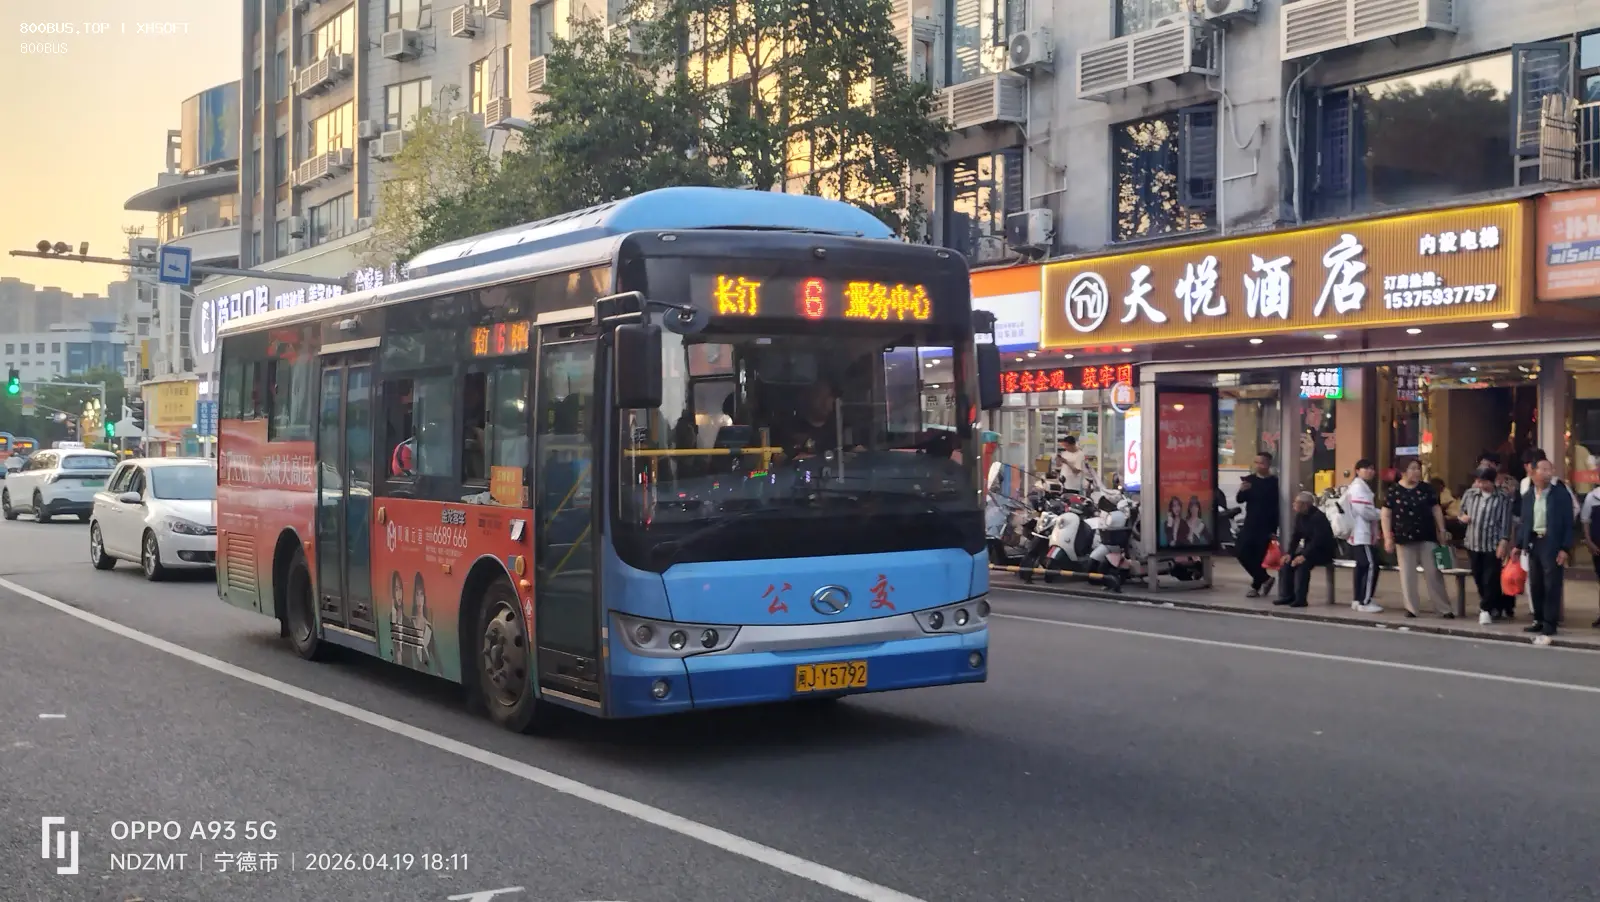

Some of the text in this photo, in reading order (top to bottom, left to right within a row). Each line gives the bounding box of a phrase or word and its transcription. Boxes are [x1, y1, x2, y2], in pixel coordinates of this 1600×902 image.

[1419, 225, 1500, 255] 内设电梯
[1121, 233, 1369, 324] 天悦酒店
[713, 275, 931, 320] 长汀 6 服务中心
[1383, 283, 1497, 309] 15375937757
[497, 323, 506, 354] 6
[1000, 364, 1132, 393] 家安全观、筑牢国
[1127, 439, 1138, 475] 6
[433, 526, 451, 546] 6689
[453, 529, 468, 549] 666
[761, 573, 896, 614] 公 交
